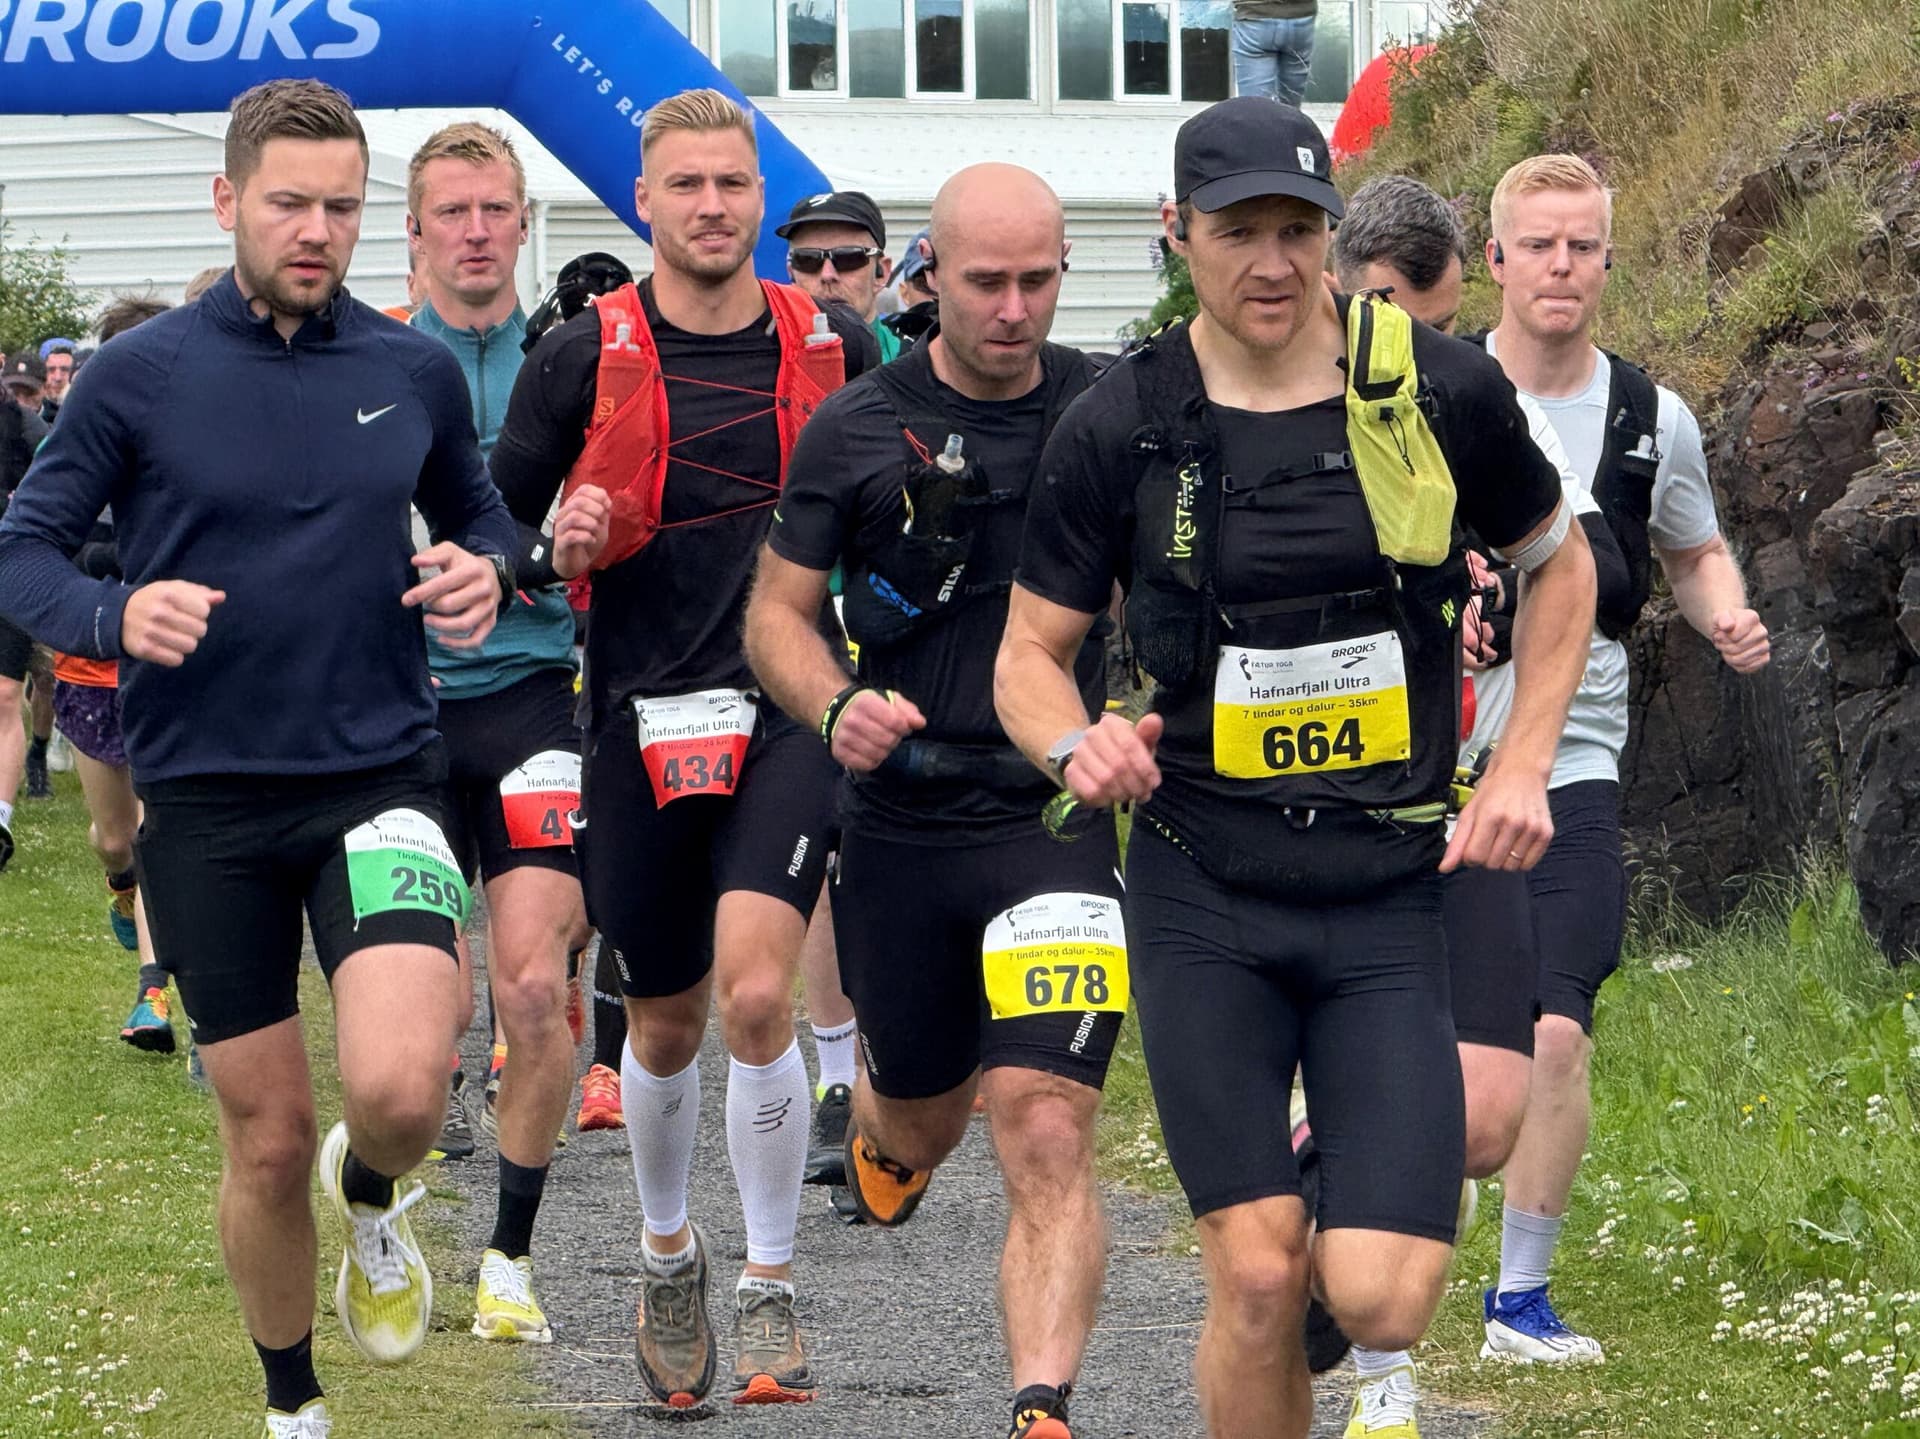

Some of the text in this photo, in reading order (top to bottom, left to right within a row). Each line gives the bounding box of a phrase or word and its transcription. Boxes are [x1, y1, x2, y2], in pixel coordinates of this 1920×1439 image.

[0, 0, 381, 63] ROOKS
[551, 33, 646, 127] LET'S RU
[1331, 641, 1377, 658] BROOKS
[708, 695, 742, 705] BROOKS
[1250, 677, 1371, 699] Hafnarfjall Ultra
[1243, 710, 1249, 719] 7
[1253, 708, 1286, 719] tindar
[1289, 706, 1304, 716] og
[1307, 701, 1335, 713] dalur
[1348, 697, 1378, 709] 35km
[647, 720, 740, 739] Hafnarfjall Ultra
[1262, 718, 1365, 770] 664
[663, 753, 734, 792] 434
[788, 834, 809, 877] FUSION
[391, 866, 463, 918] 259
[1080, 899, 1110, 911] BROOKS
[1013, 926, 1109, 942] Hafnarfjall Ultra
[1008, 952, 1014, 961] 7
[1016, 949, 1044, 961] tindar
[1047, 949, 1059, 958] og
[1062, 946, 1086, 956] dalur
[1095, 947, 1115, 958] 35km
[1025, 964, 1109, 1007] 678
[1069, 1010, 1098, 1054] FUSION
